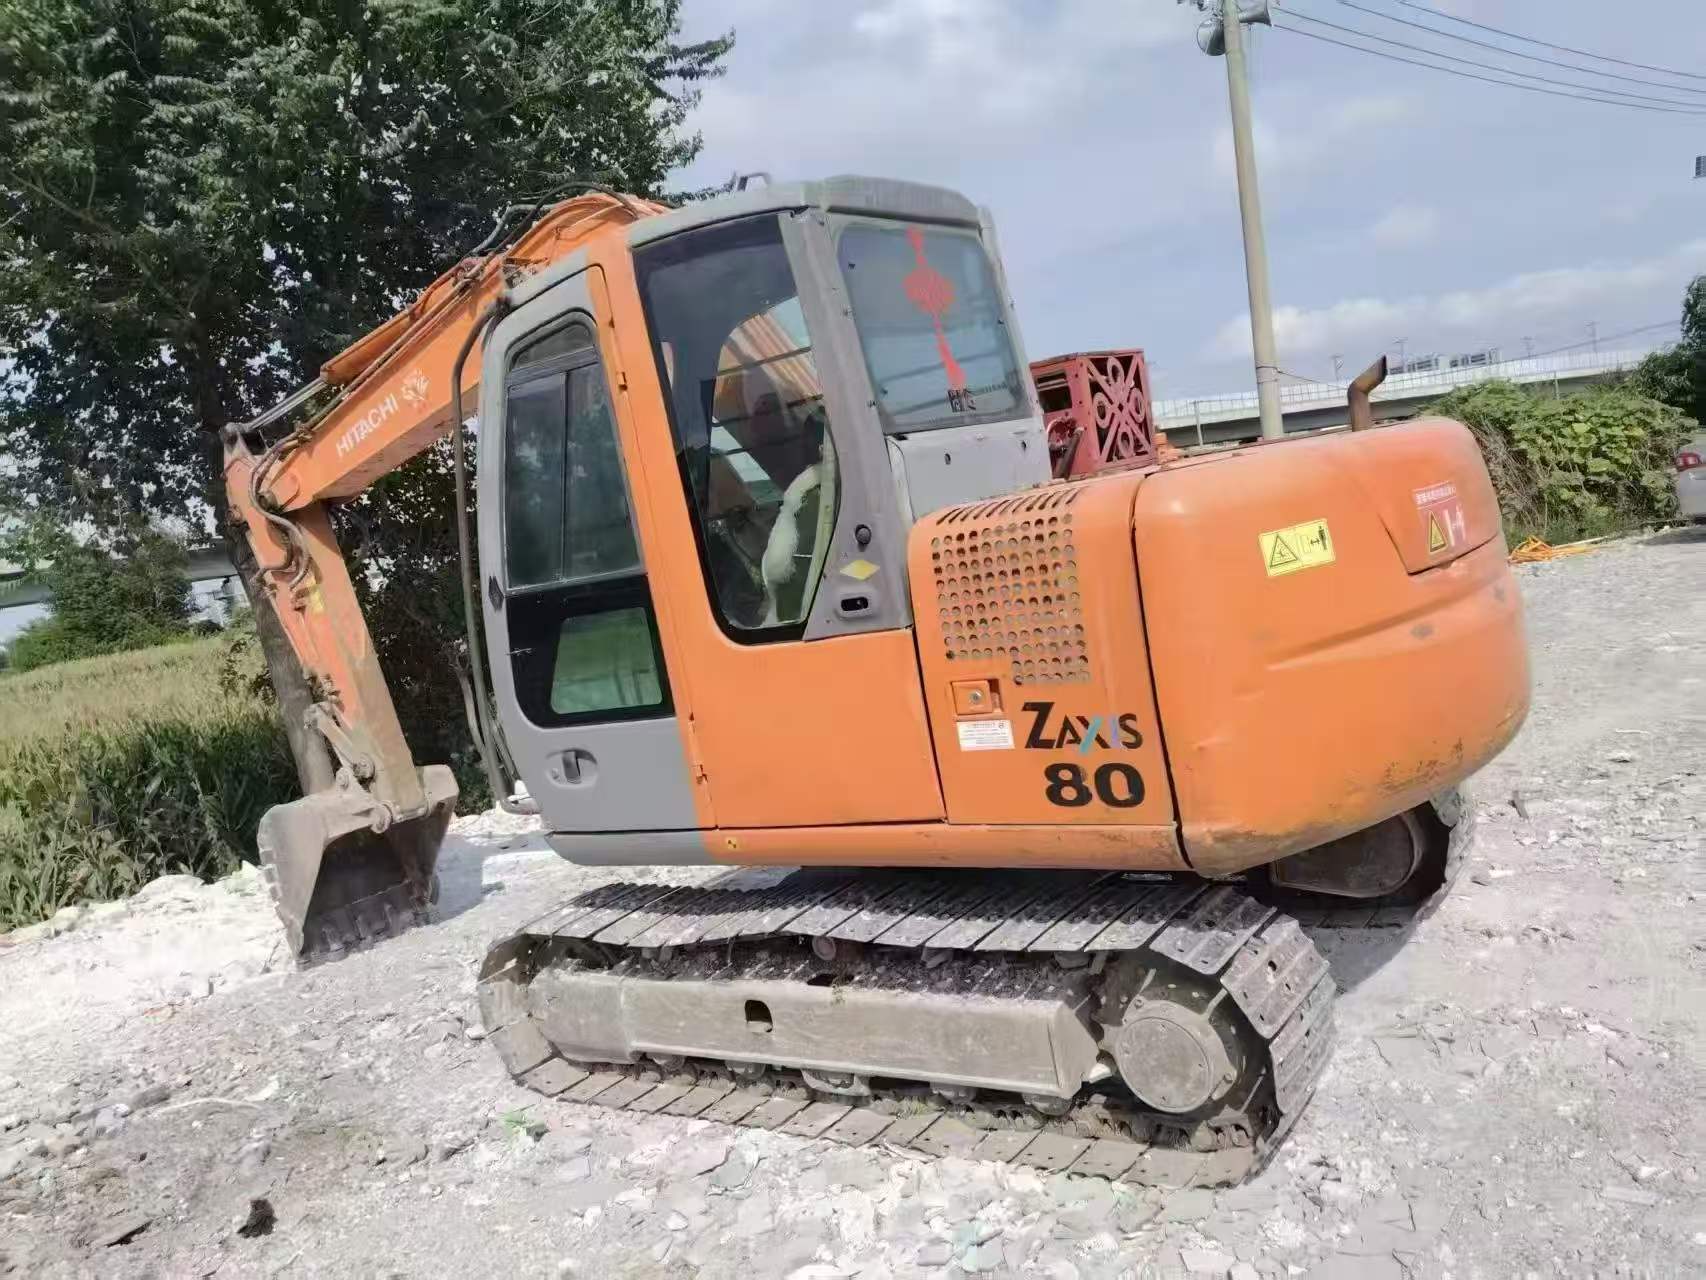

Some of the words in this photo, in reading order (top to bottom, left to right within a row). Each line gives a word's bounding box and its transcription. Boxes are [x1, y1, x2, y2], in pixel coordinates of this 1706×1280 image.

[335, 394, 399, 457] HITACHI
[1021, 701, 1143, 754] ZAXIS
[1044, 762, 1145, 808] 80
